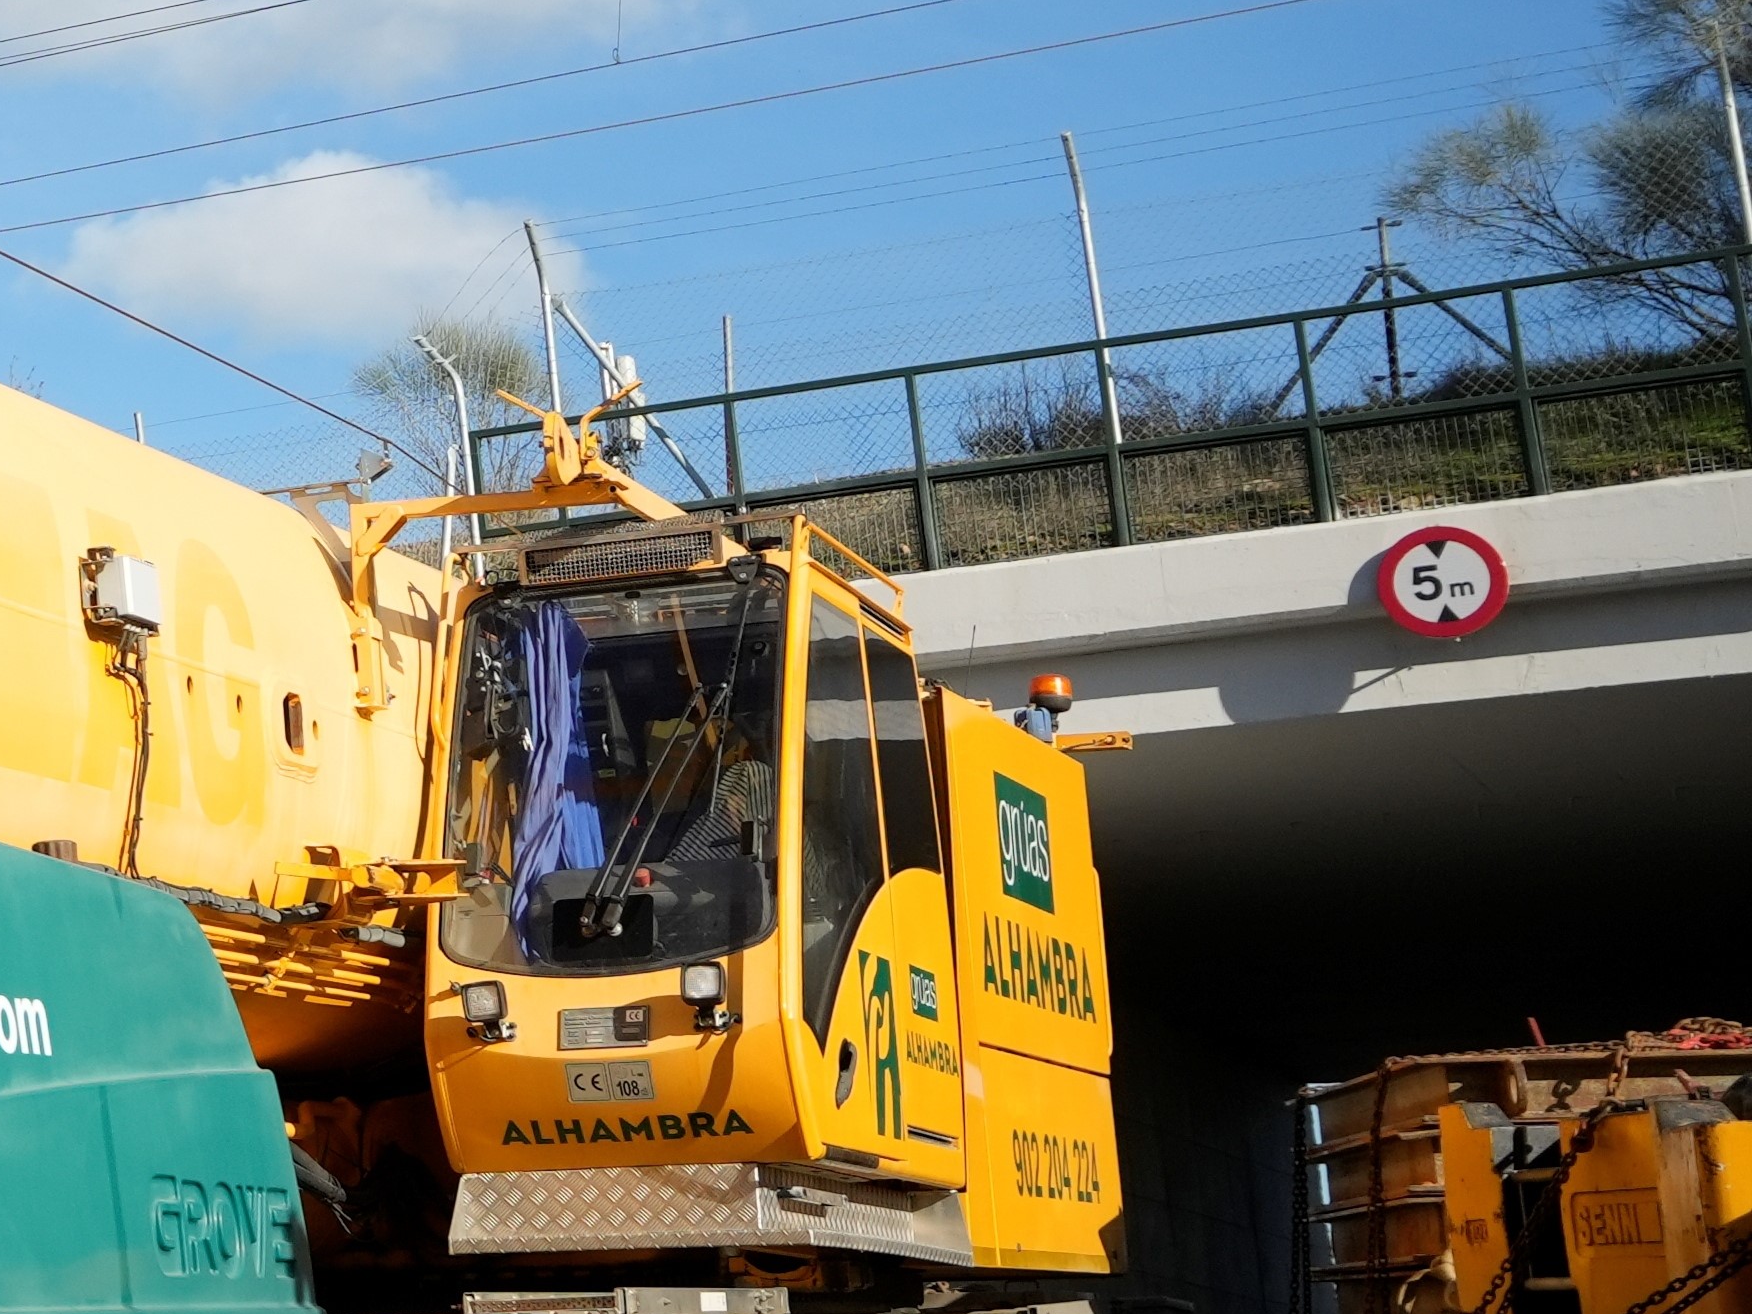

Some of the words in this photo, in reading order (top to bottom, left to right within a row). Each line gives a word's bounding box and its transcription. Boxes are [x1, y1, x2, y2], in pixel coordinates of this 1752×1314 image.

[1412, 564, 1443, 601] 5
[1449, 581, 1475, 597] m
[998, 798, 1050, 886] grúas
[909, 972, 937, 1012] grúas
[984, 911, 1097, 1024] ALHAMBRA
[906, 1029, 960, 1079] ALHAMBRA
[616, 1079, 641, 1098] 108
[502, 1108, 755, 1147] ALHAMBRA
[1012, 1128, 1043, 1198] 902
[1044, 1132, 1072, 1201] 204
[1073, 1141, 1101, 1204] 224
[150, 1172, 299, 1281] GROVE
